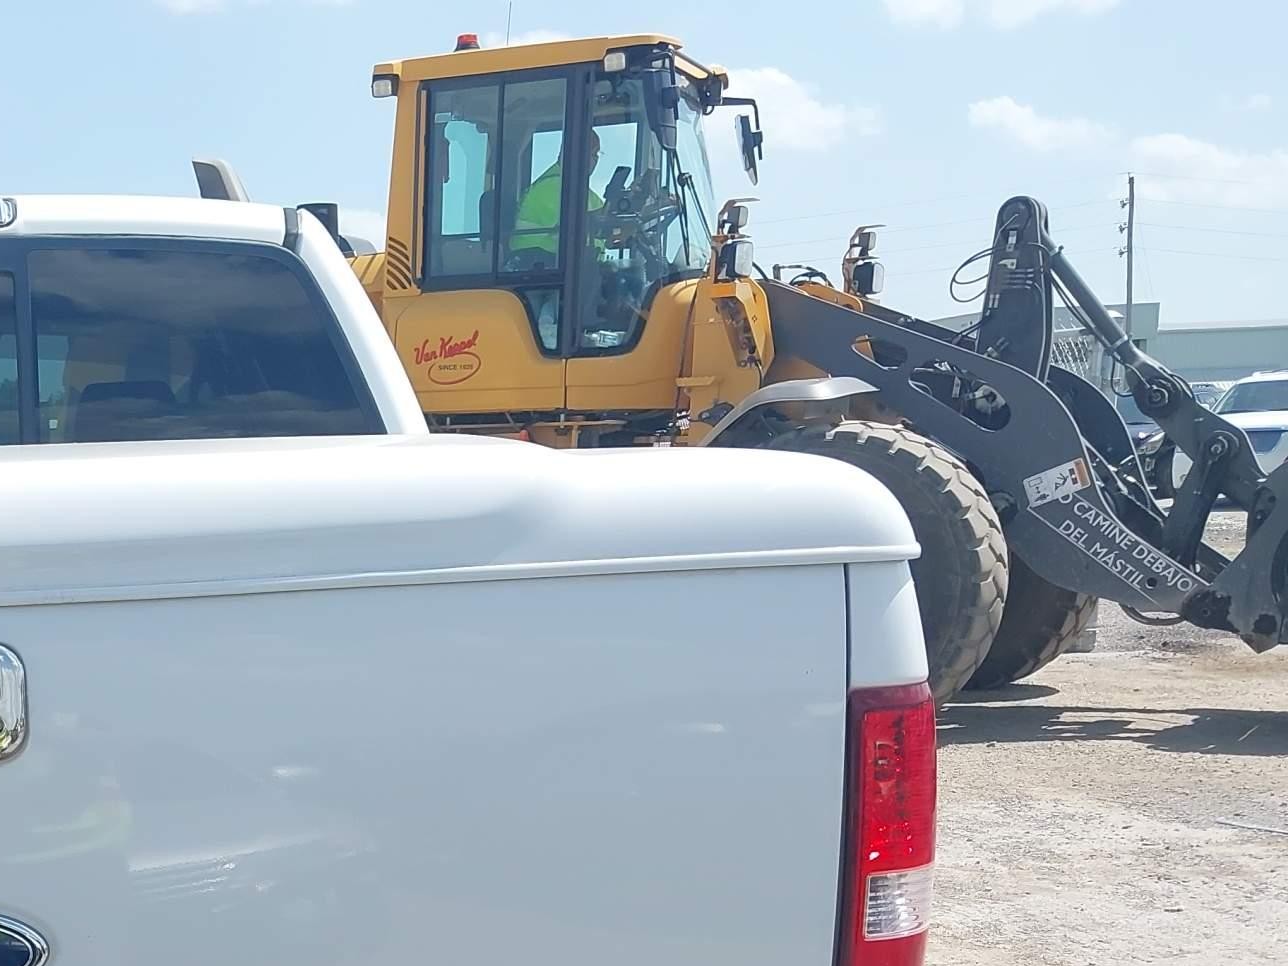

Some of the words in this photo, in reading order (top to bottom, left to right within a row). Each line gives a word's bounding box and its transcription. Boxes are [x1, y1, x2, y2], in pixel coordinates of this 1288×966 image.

[1059, 519, 1089, 548] DEL
[1089, 541, 1146, 589] MÁSTIL
[1073, 501, 1135, 550] CAMINE
[1132, 544, 1192, 592] DEBAJO
